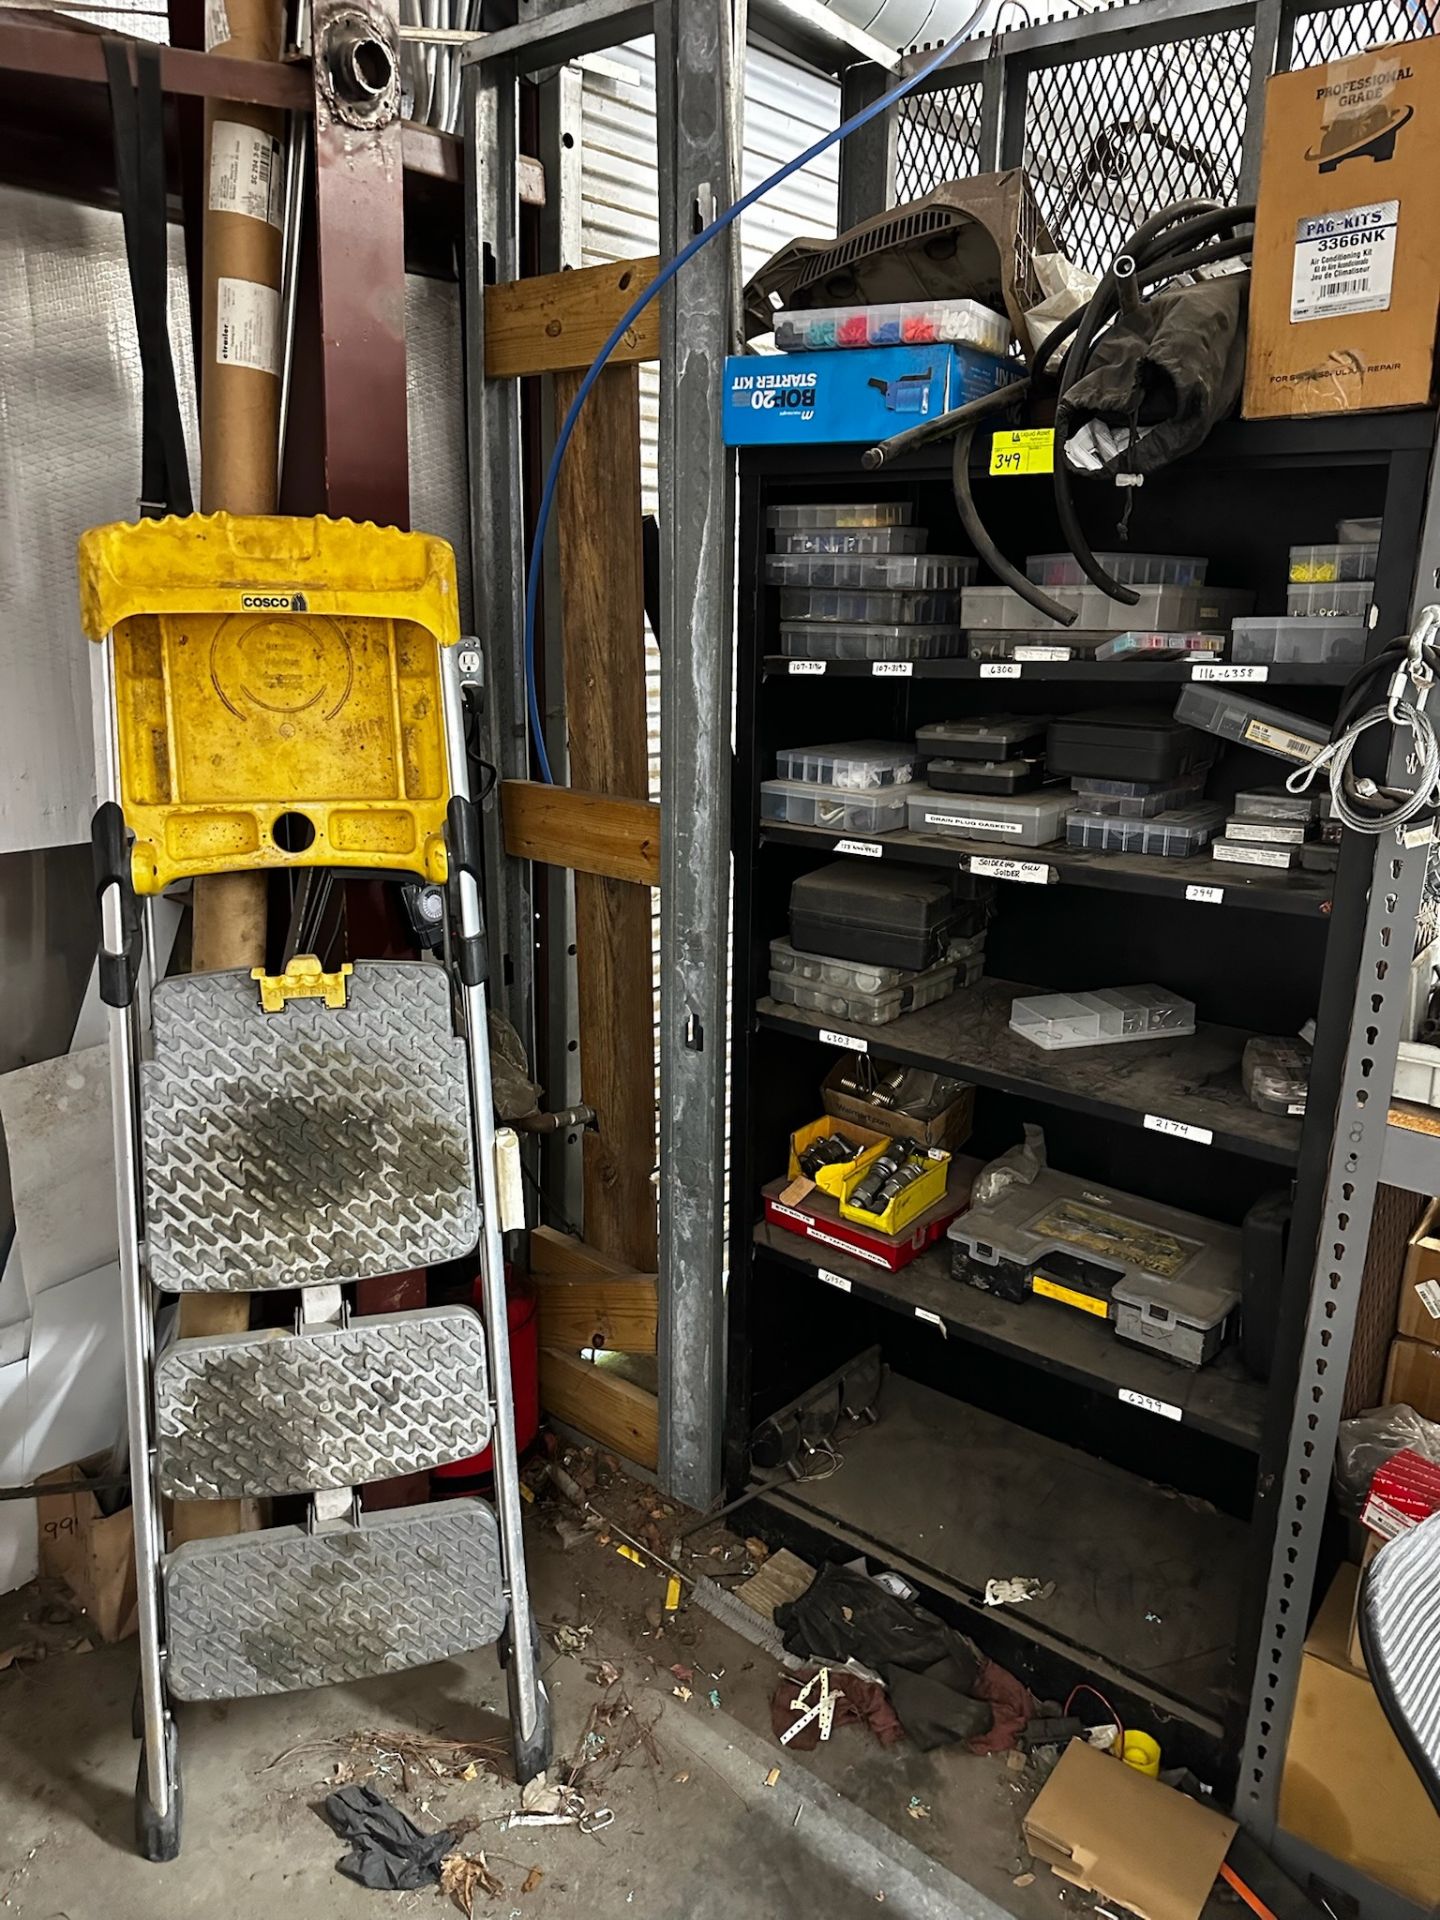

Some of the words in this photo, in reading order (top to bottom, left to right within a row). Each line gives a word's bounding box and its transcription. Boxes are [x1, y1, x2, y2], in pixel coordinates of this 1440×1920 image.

[1315, 66, 1414, 100] PROFESSIONAL
[1338, 87, 1384, 107] GRADE
[1306, 209, 1383, 236] PAG-KITS
[1317, 229, 1386, 252] 3366NK
[1310, 257, 1320, 266] Air
[1321, 250, 1361, 265] Conditioning
[1362, 248, 1373, 257] Kit
[1310, 272, 1323, 282] Jeu
[1324, 271, 1332, 280] de
[756, 372, 818, 389] STARTER
[1269, 375, 1288, 384] FOR
[1367, 362, 1401, 373] REPAIR
[731, 376, 754, 390] KIT
[750, 388, 816, 410] BOP20
[994, 452, 1021, 470] 349
[243, 597, 289, 608] COSCO
[990, 666, 1013, 674] 6300
[1199, 667, 1255, 679] 116-6358
[930, 815, 954, 824] DRAIN
[978, 822, 1017, 831] GASKETS
[1021, 862, 1041, 872] GUN
[1192, 888, 1214, 898] 294
[1155, 1118, 1189, 1135] 2174
[279, 1257, 361, 1284] COSCO
[1128, 1392, 1163, 1413] 6299
